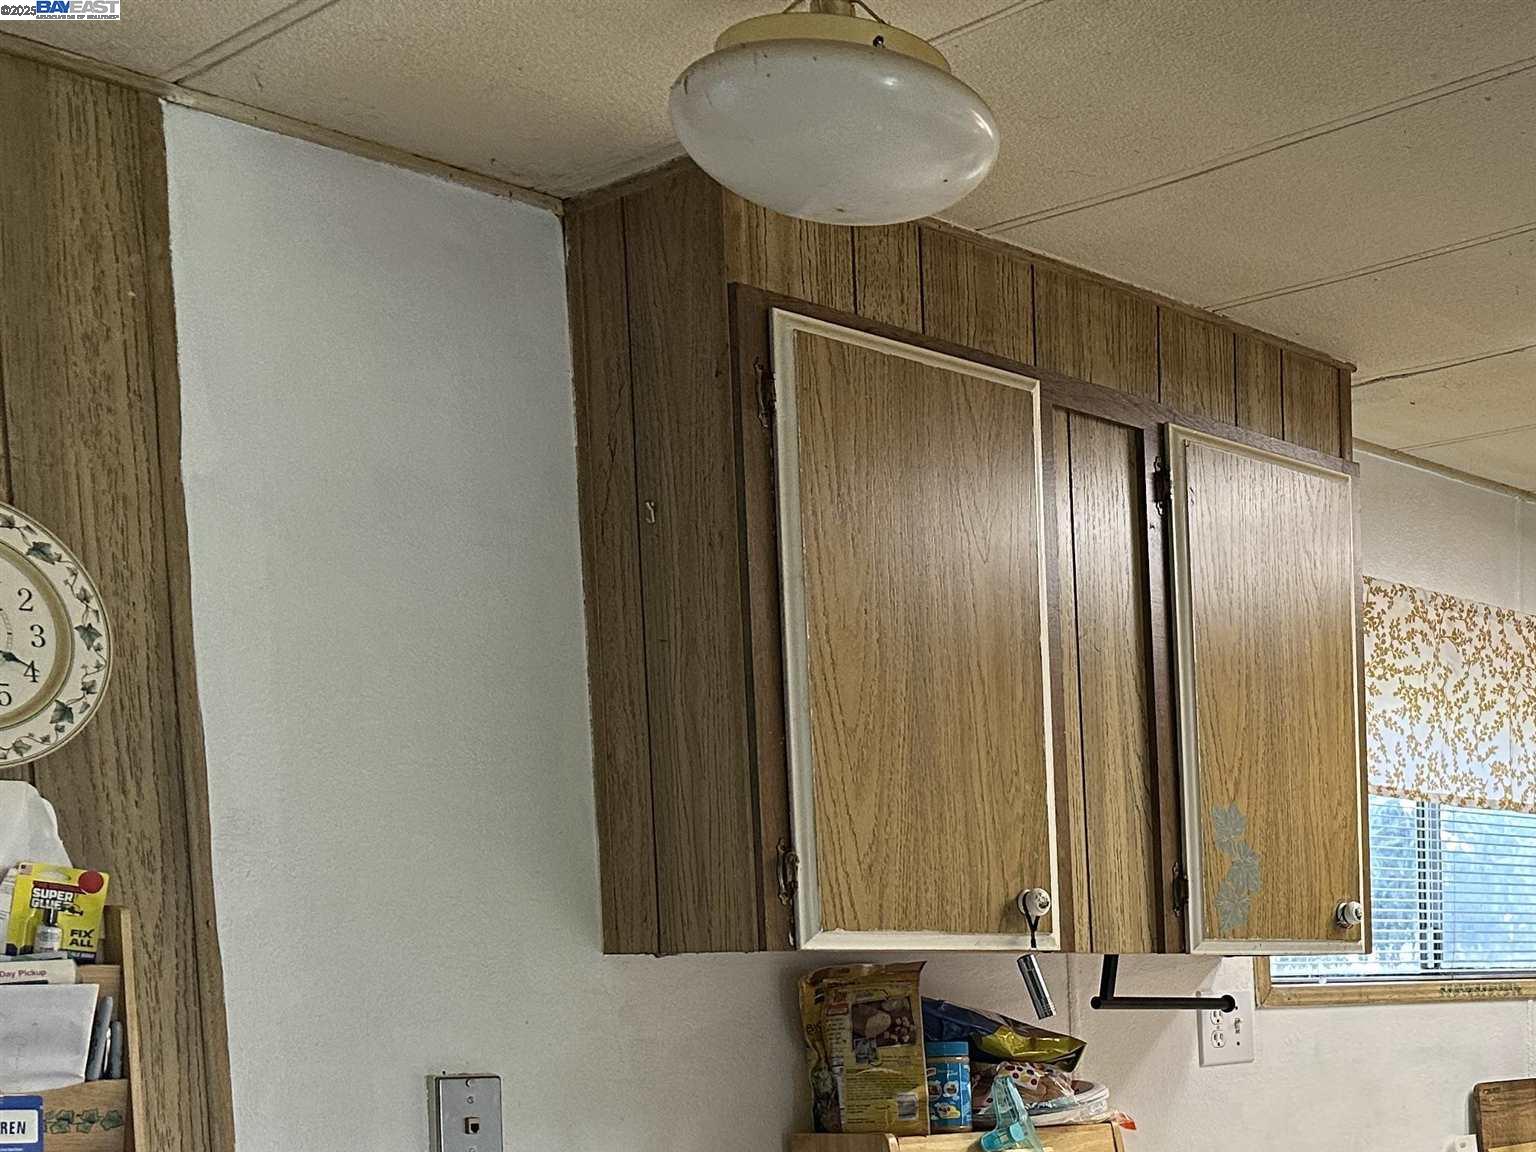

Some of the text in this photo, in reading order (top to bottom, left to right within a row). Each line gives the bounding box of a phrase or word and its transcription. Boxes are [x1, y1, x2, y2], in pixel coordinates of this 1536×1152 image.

[17, 588, 34, 612] 2
[30, 624, 46, 648] 3
[23, 660, 40, 683] 4
[32, 887, 74, 901] SUPER
[31, 899, 62, 910] GLUE
[70, 929, 95, 938] FIX
[69, 939, 94, 948] ALL
[18, 969, 47, 977] Pickup
